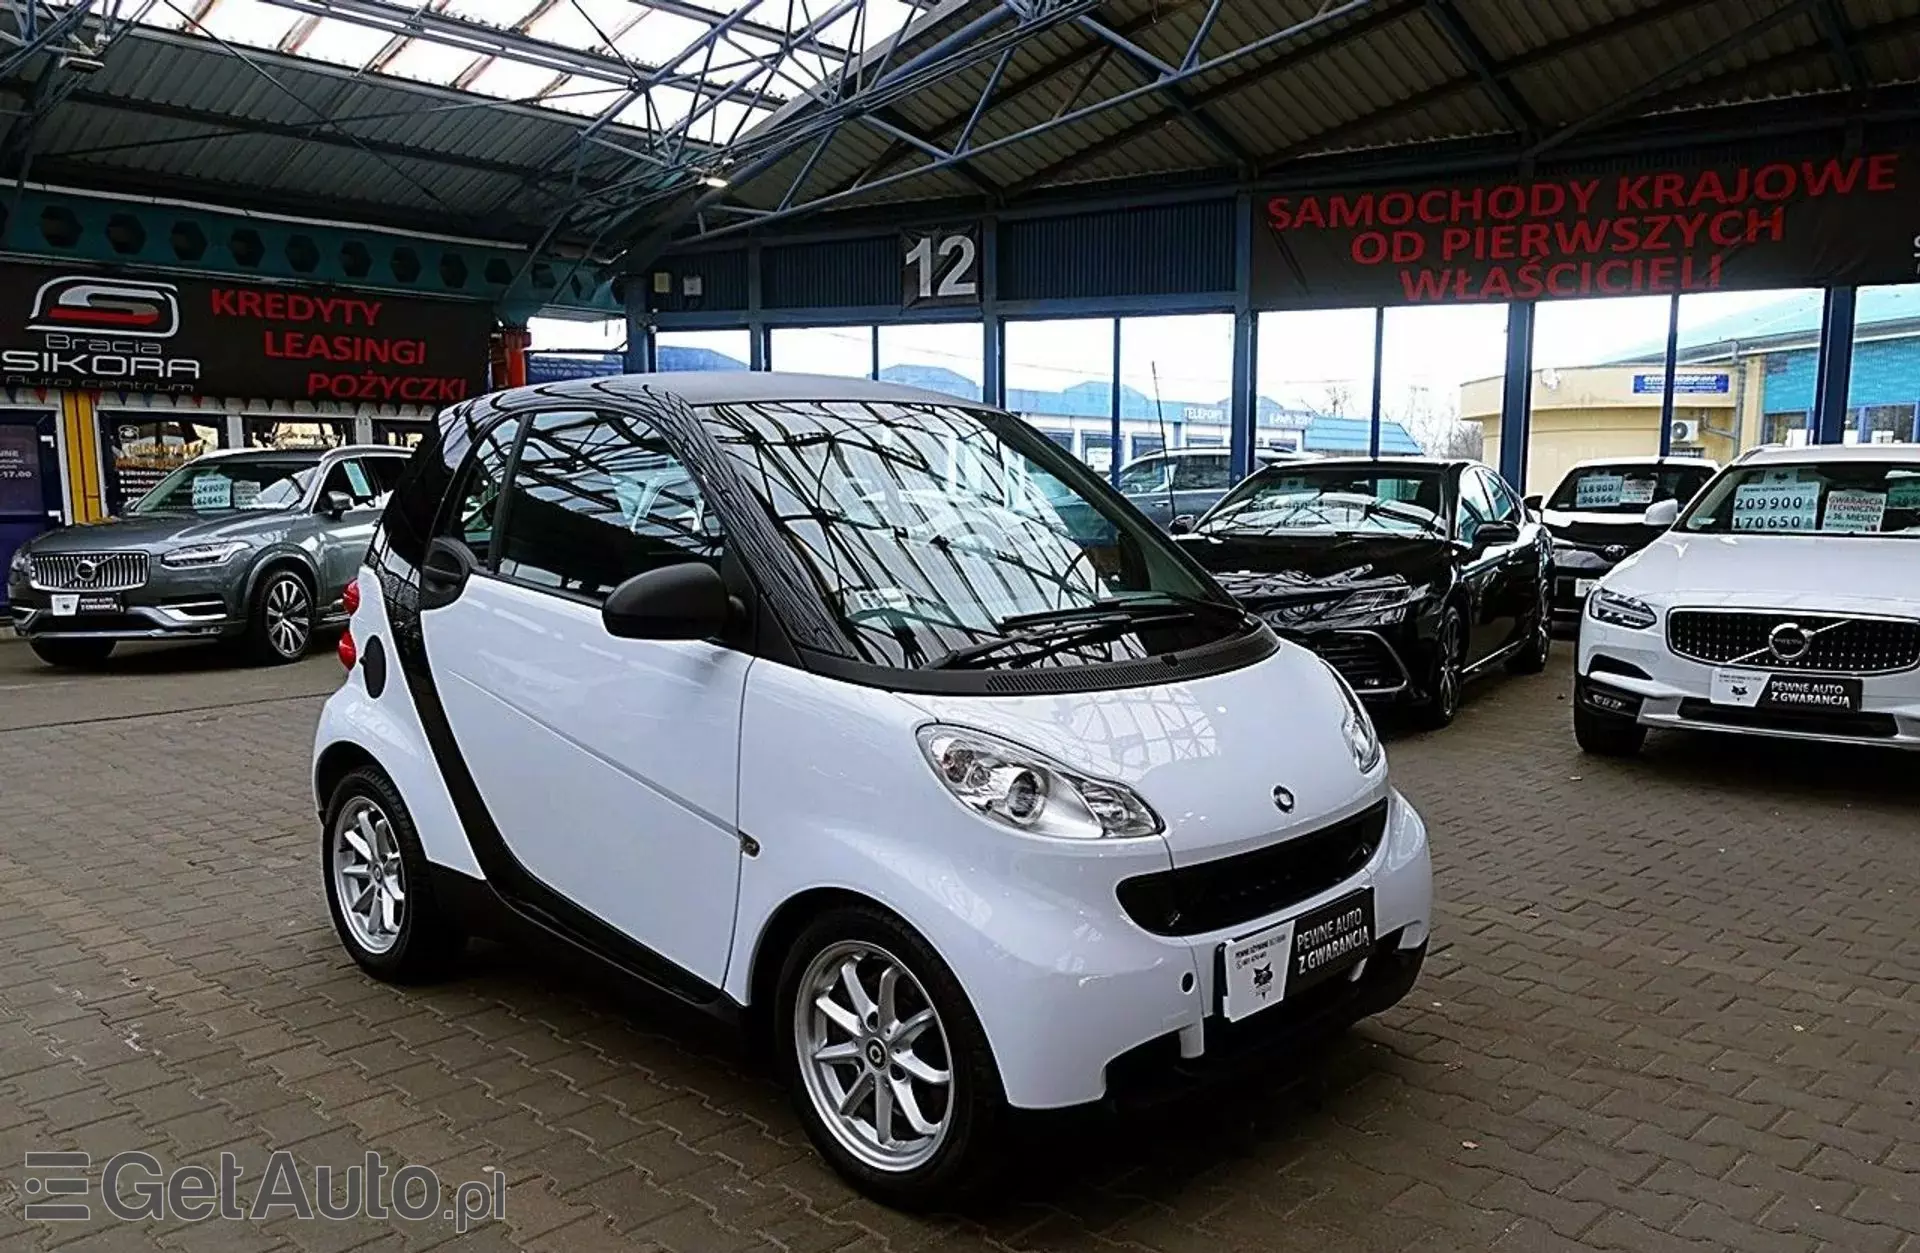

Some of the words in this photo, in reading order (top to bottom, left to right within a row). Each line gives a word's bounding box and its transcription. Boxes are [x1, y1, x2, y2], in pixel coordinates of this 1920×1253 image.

[1267, 178, 1600, 231] SAMOCHODY
[1617, 154, 1899, 211] KRAJOWE
[1351, 230, 1426, 265] OD
[1443, 206, 1786, 261] PIERWSZYCH
[906, 235, 976, 297] 12
[1401, 253, 1723, 301] WŁAŚCICIELI
[211, 288, 382, 326] KREDYTY
[45, 333, 162, 354] Bracia
[264, 330, 427, 365] LEASINGI
[1, 350, 200, 379] SIKORA
[307, 369, 468, 400] POŻYCZKI
[1735, 496, 1802, 510] 209900
[1734, 515, 1800, 529] 170650
[1771, 681, 1809, 693] PEWNE
[1811, 684, 1844, 695] AUTO
[1771, 691, 1779, 702] Z
[1297, 920, 1335, 952] PEWNE
[1336, 908, 1362, 932] AUTO
[1298, 955, 1307, 975] Z
